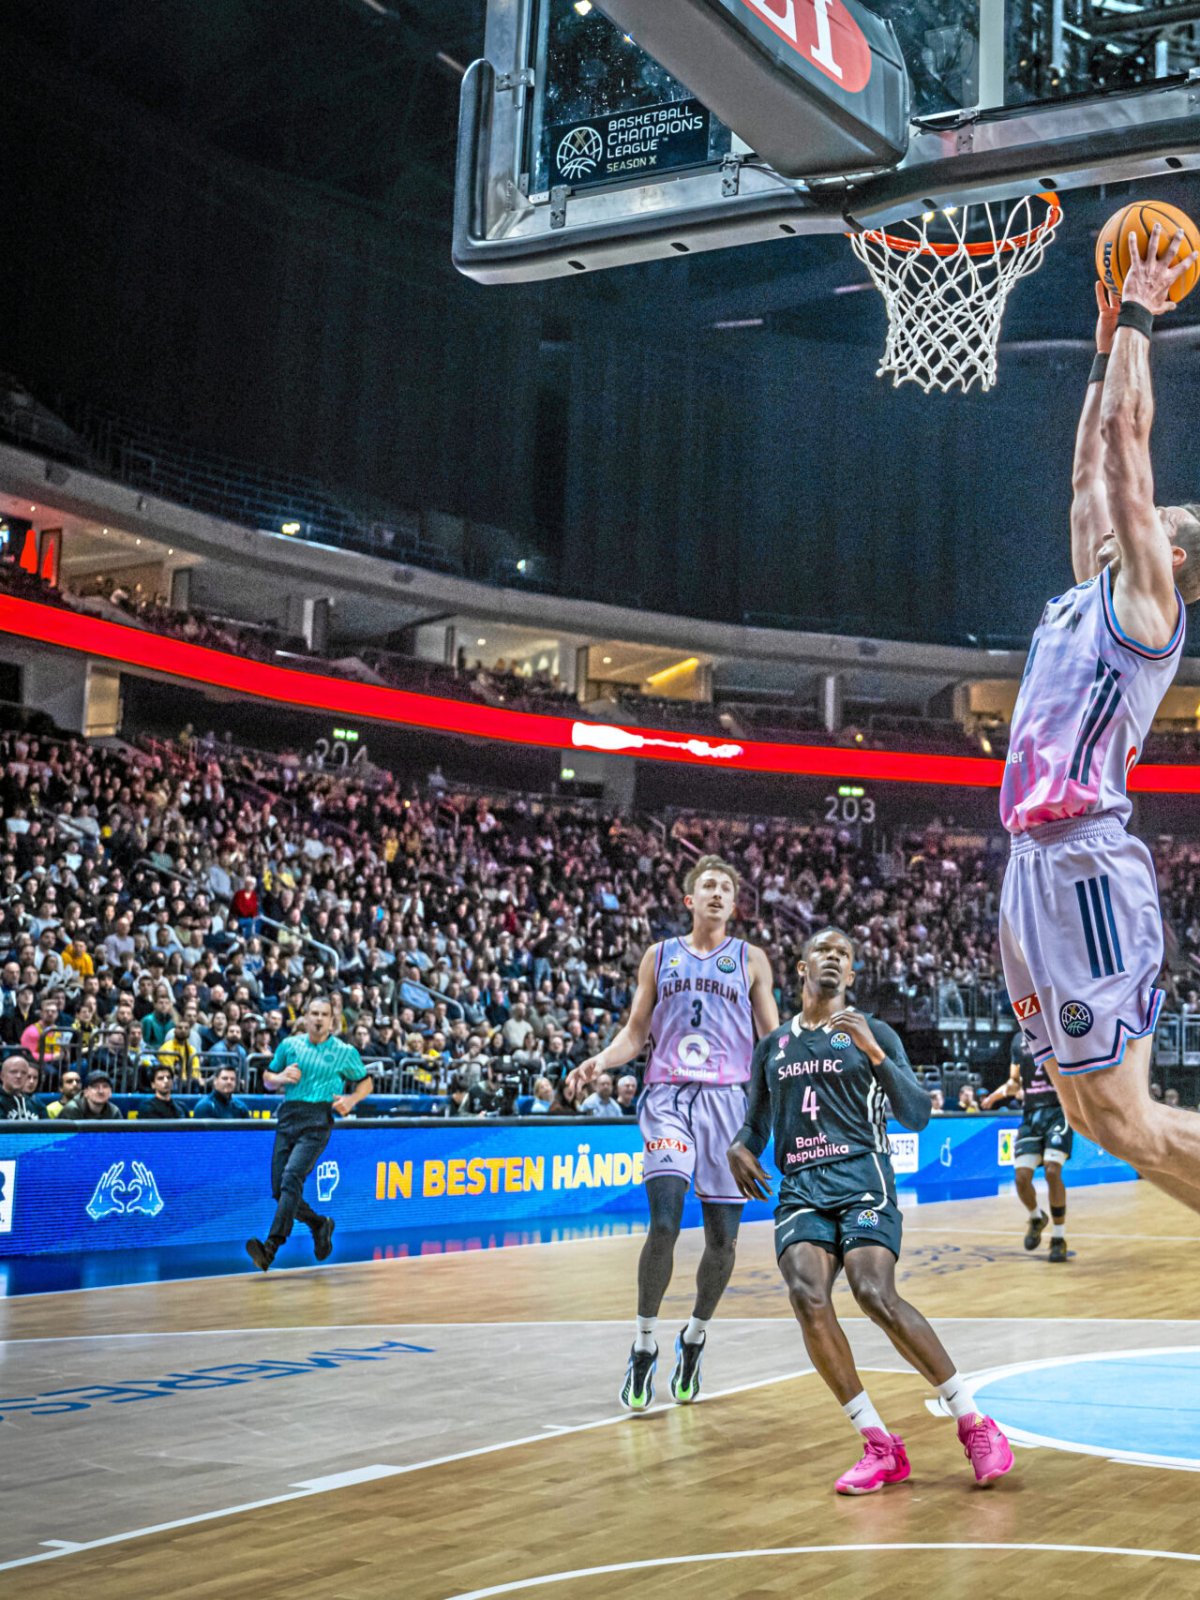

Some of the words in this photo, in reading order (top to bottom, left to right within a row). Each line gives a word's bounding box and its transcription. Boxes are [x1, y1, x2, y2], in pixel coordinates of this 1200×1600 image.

[607, 116, 703, 146] CHAMPIONS
[608, 105, 693, 131] BASKETBALL
[606, 138, 660, 159] LEAGUE
[606, 157, 647, 173] SEASON
[649, 155, 657, 165] X
[825, 797, 876, 824] 203
[662, 978, 692, 1001] ALBA
[695, 978, 738, 1004] BERLIN
[690, 999, 703, 1028] 3
[667, 1066, 718, 1079] Schindler
[778, 1060, 819, 1080] SABAH
[823, 1059, 843, 1073] BC
[801, 1085, 820, 1121] 4
[649, 1138, 688, 1153] GAZI
[795, 1132, 828, 1149] Bank
[375, 1160, 413, 1200] IN
[422, 1156, 545, 1198] BESTEN
[552, 1143, 644, 1190] HÄNDE
